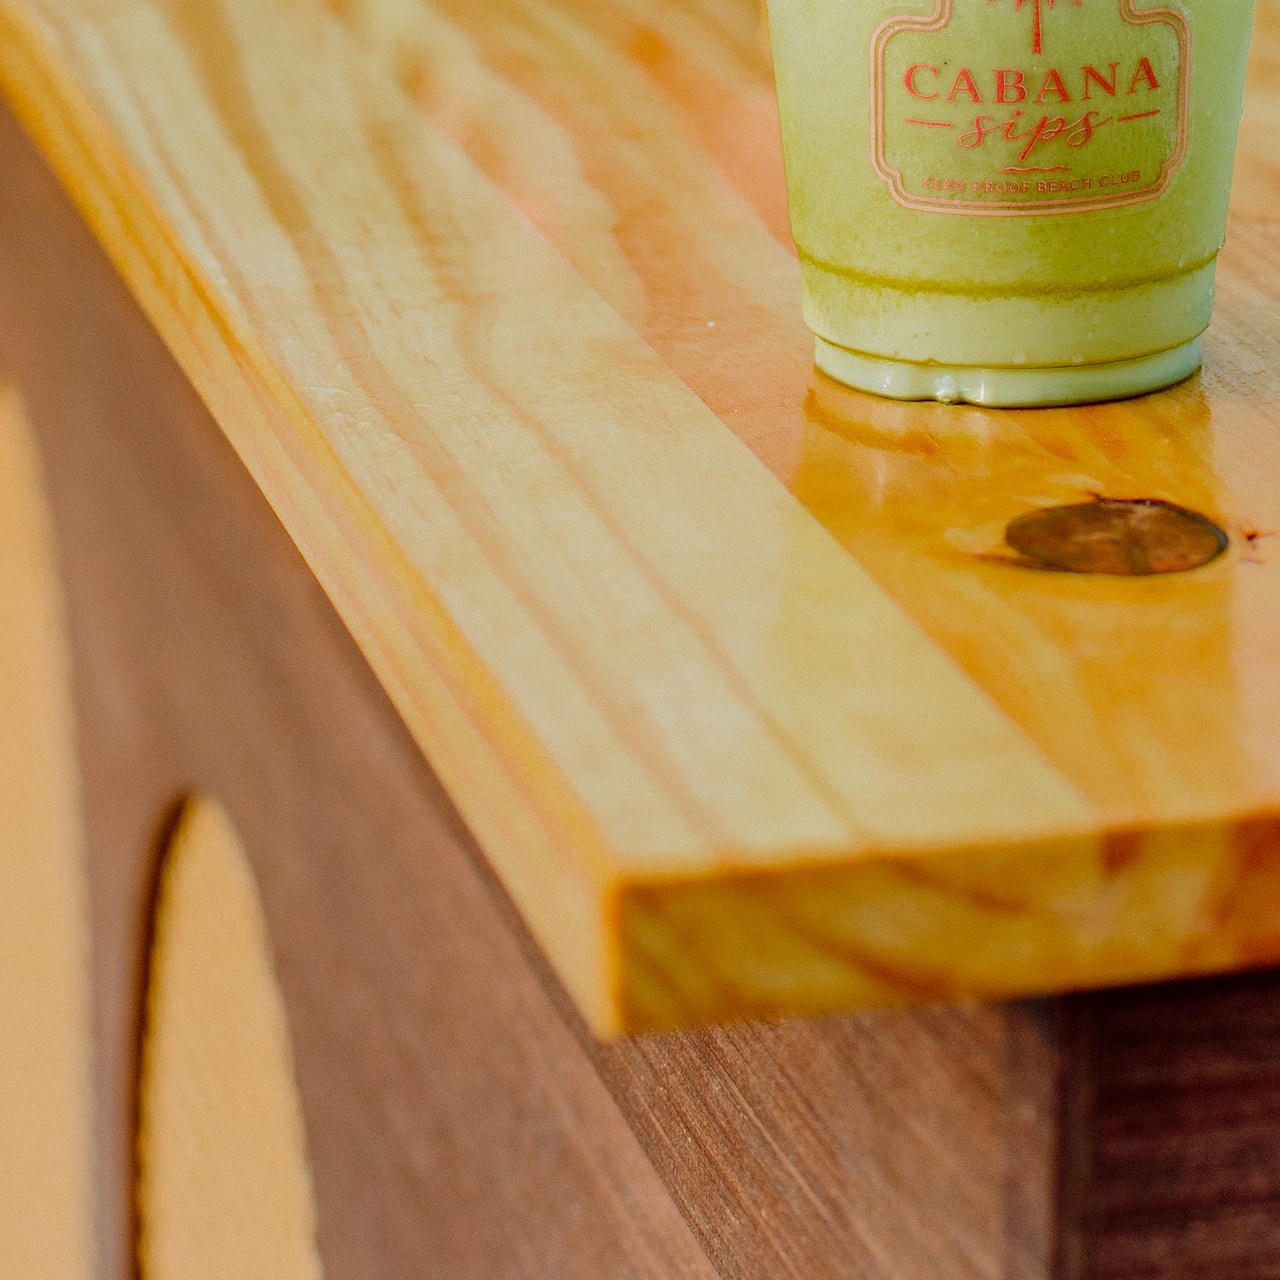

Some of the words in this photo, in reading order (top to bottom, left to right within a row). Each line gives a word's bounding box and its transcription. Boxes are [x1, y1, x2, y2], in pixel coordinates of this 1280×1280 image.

[903, 56, 1161, 105] CABANA
[957, 109, 1112, 161] sips
[923, 176, 965, 192] ZERO
[972, 181, 1030, 193] PROOF
[1037, 178, 1092, 192] BEACH
[1099, 170, 1141, 188] CLUB
